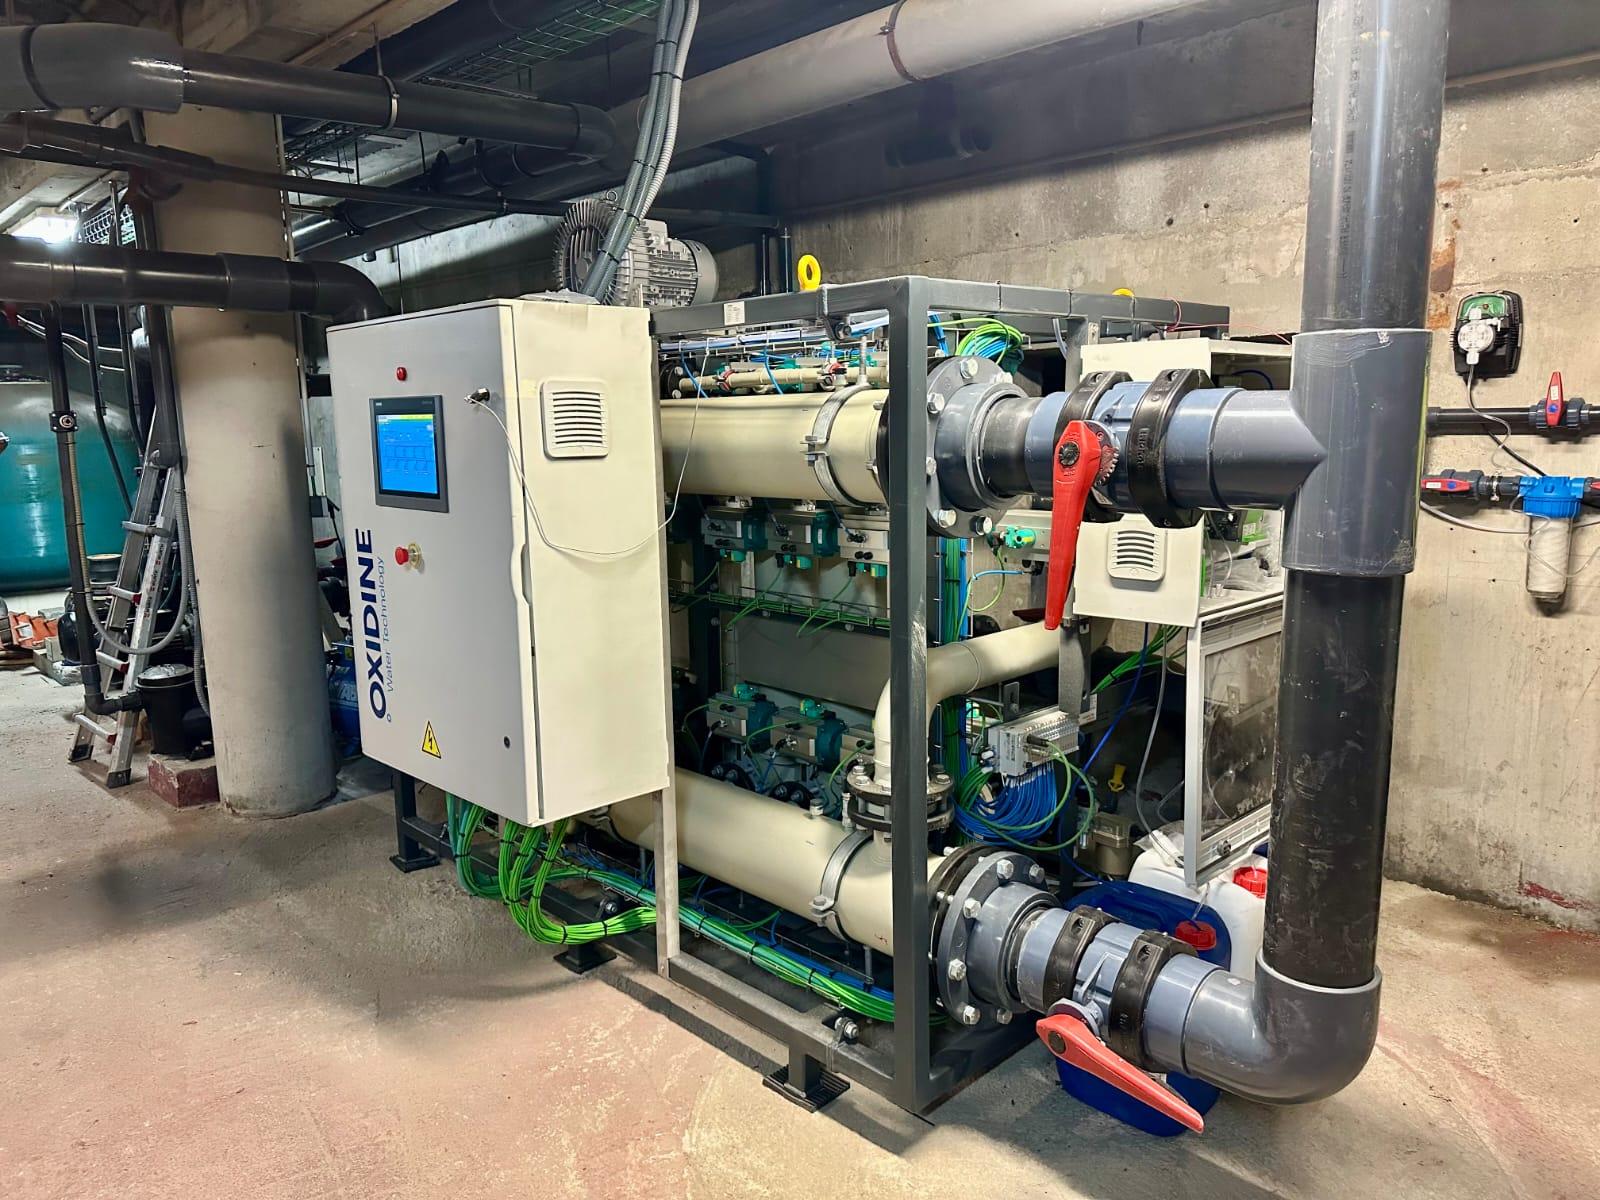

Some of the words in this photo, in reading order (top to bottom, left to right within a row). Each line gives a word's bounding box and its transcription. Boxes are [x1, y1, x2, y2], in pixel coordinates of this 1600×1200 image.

[355, 528, 387, 719] OXIDINE
[377, 556, 389, 643] Technology
[384, 652, 394, 692] Water
